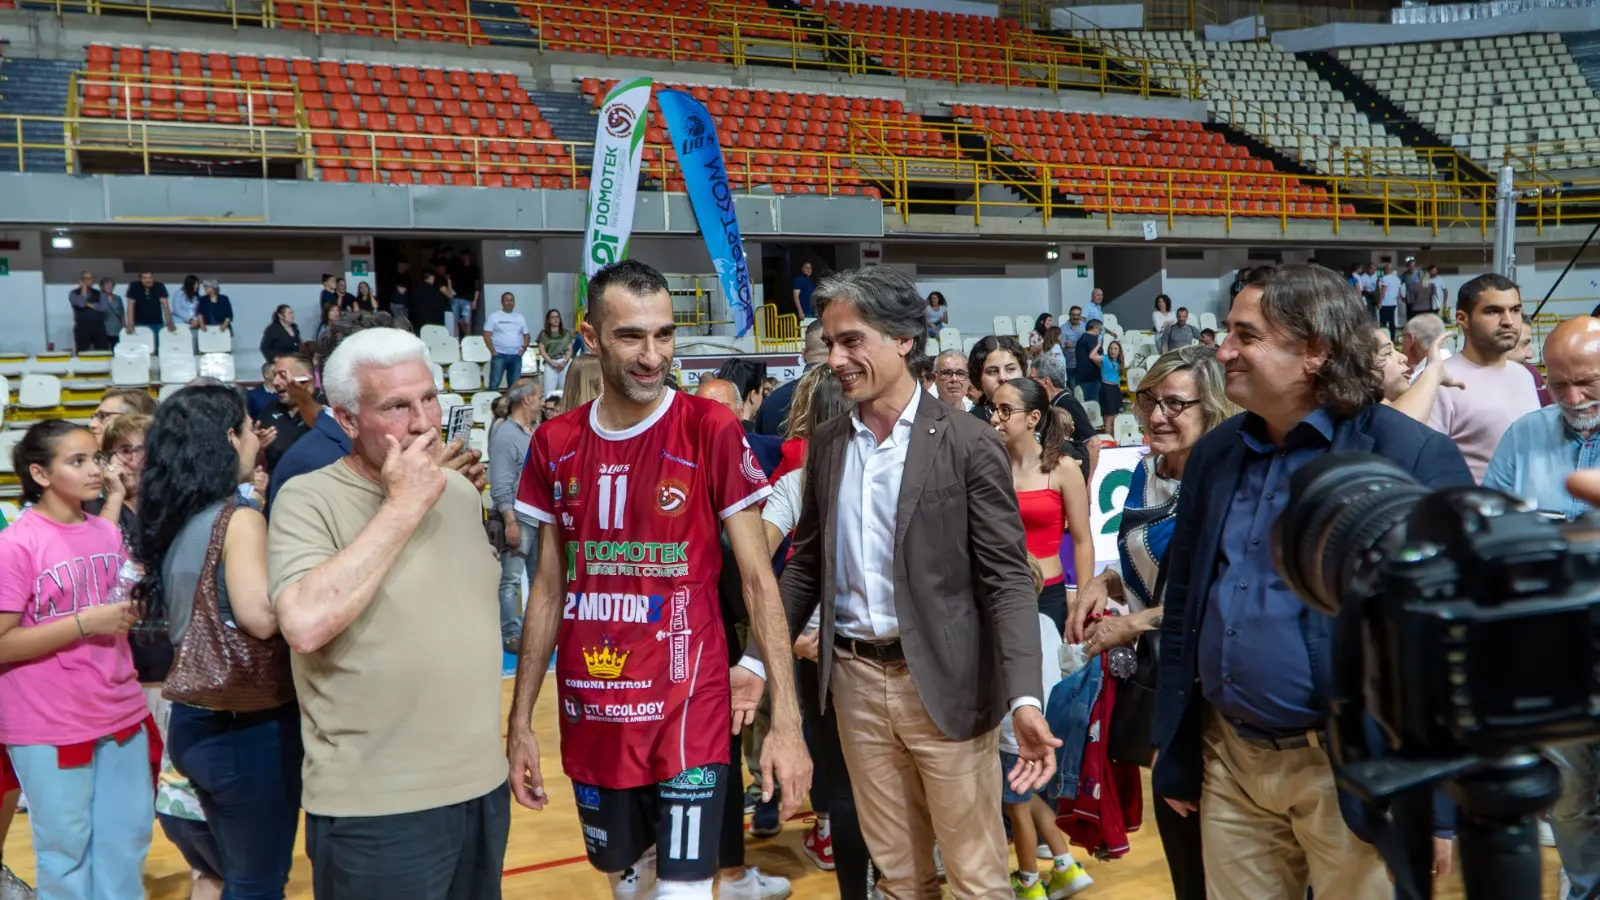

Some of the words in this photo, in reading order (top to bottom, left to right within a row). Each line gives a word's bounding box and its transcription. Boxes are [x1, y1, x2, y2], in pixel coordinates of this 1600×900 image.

[595, 145, 618, 226] DOMOTEK
[1147, 224, 1153, 233] 5
[597, 474, 627, 530] 11
[584, 541, 689, 563] DOMOTEK
[643, 566, 689, 577] COMFORT
[673, 635, 685, 680] DROGHERIA
[565, 679, 605, 689] CORONA
[606, 680, 652, 690] PETROLI
[584, 703, 604, 716] CTL
[605, 701, 665, 717] ECOLOGY
[669, 804, 701, 860] 11
